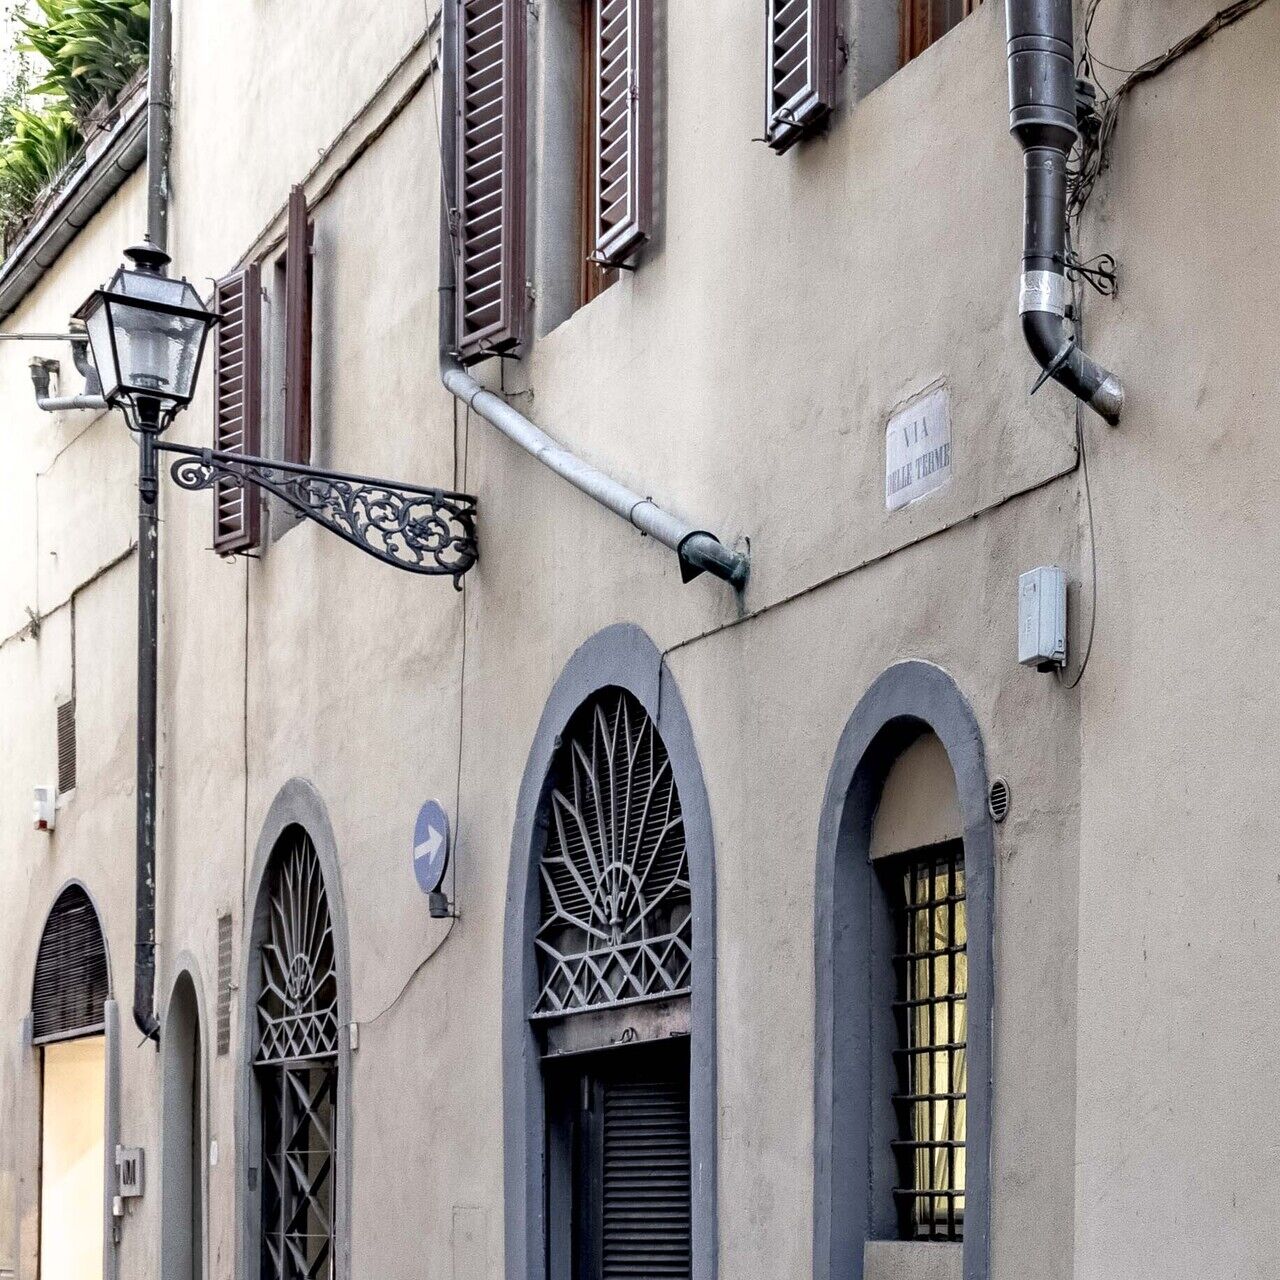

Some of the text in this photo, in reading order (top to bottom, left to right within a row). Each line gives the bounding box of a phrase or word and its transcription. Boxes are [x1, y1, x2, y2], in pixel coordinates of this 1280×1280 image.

[904, 416, 929, 448] VIA
[887, 443, 950, 497] DELLE TERME
